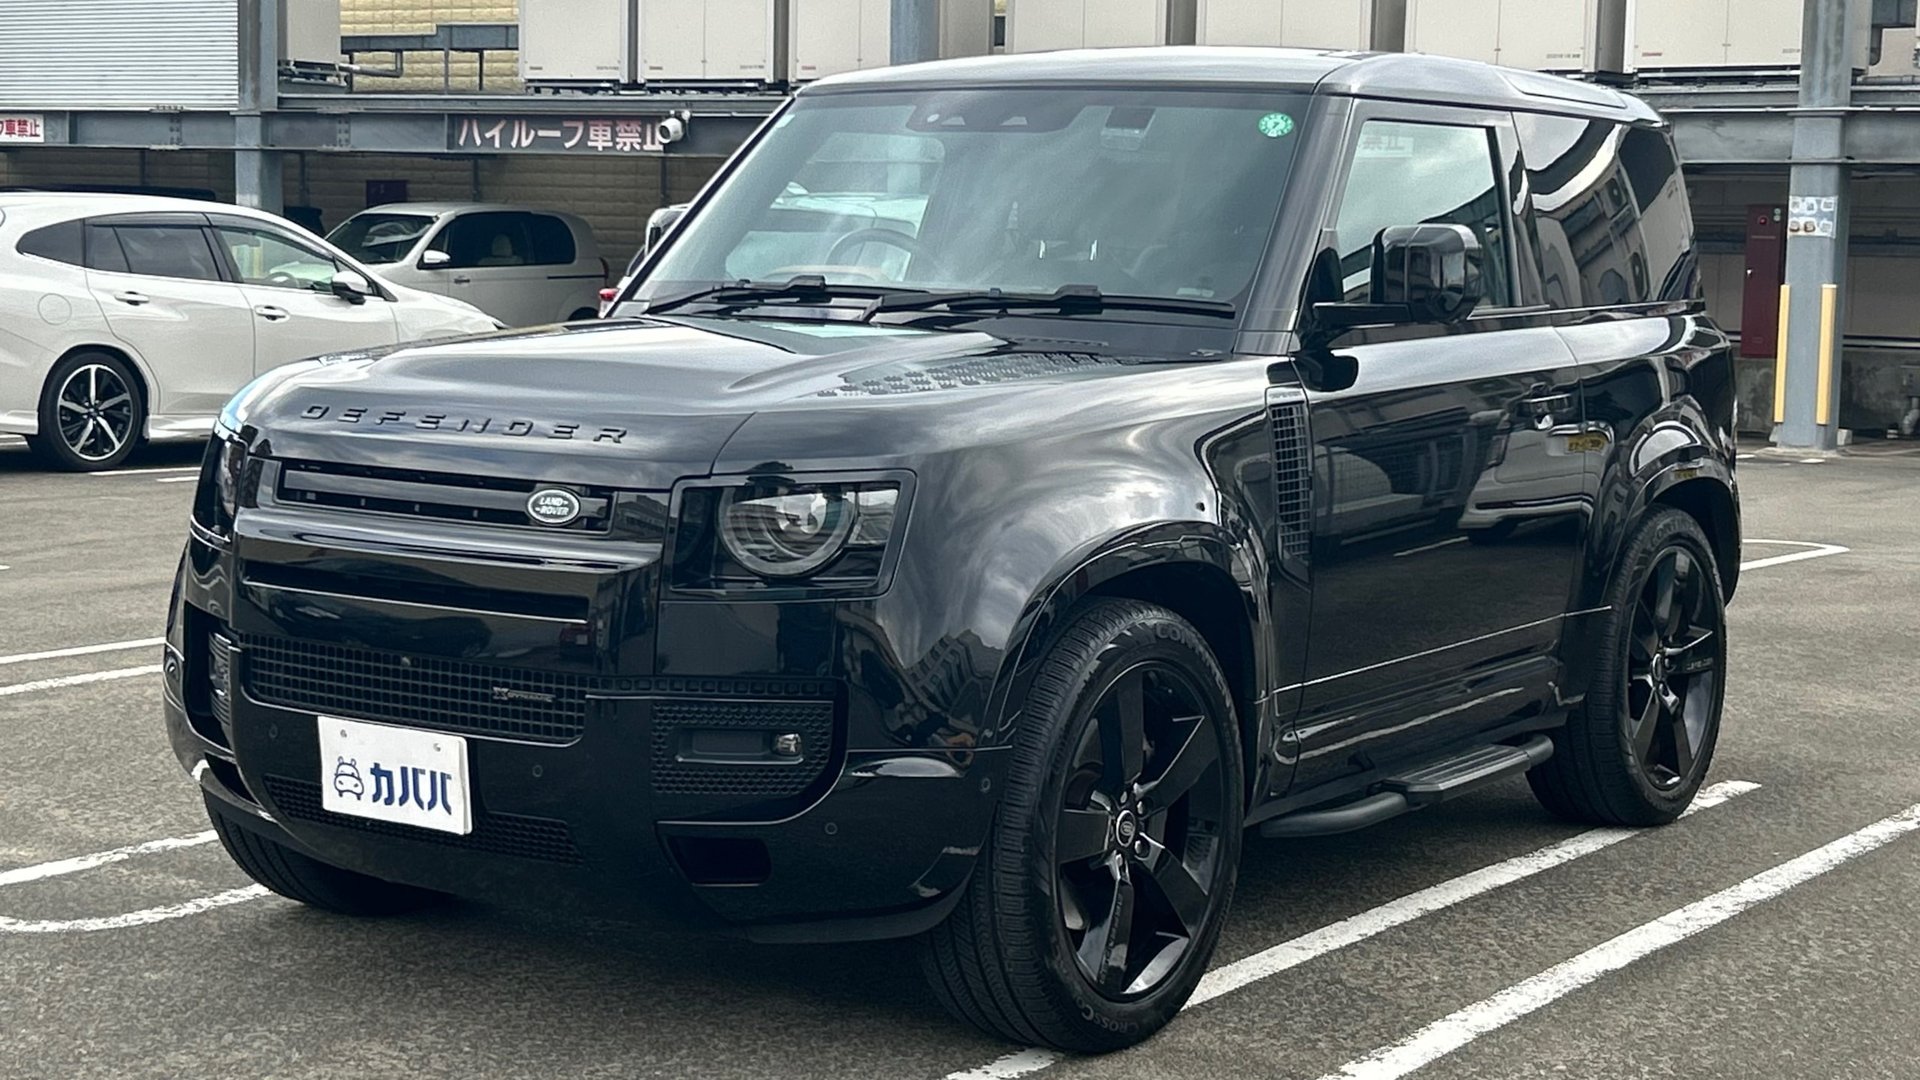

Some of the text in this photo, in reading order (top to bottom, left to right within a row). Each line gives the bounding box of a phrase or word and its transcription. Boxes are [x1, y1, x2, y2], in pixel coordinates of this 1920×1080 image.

[458, 119, 665, 152] ハイルーフ車禁止
[300, 405, 628, 444] DEFENDER
[539, 497, 563, 507] LAND
[540, 506, 569, 516] ROVER
[370, 762, 453, 816] カババ
